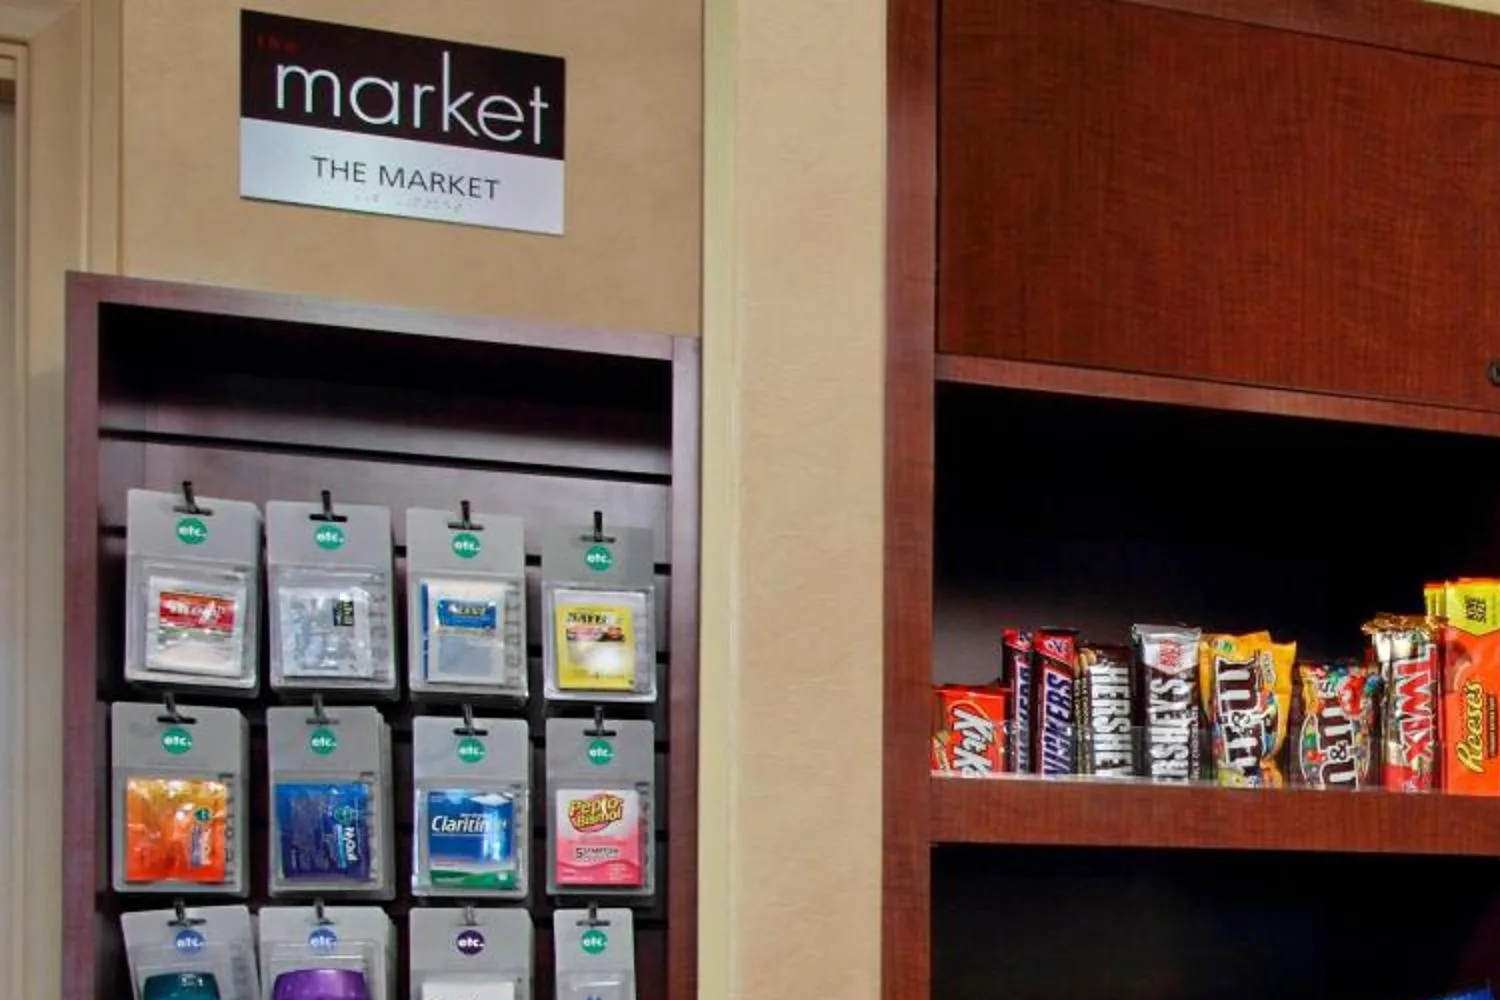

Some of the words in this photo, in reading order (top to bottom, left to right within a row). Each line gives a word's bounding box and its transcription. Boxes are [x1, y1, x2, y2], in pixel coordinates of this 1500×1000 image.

[275, 50, 549, 145] market
[311, 156, 367, 184] THE
[379, 165, 500, 200] MARKET
[178, 525, 207, 537] etc.
[316, 532, 344, 543] etc.
[1392, 649, 1438, 762] TWIX
[1151, 677, 1192, 781] ERSHEY'S
[1457, 681, 1486, 773] Reese's
[164, 735, 192, 747] etc.
[311, 736, 337, 748] etc.
[588, 747, 614, 758] etc.
[176, 936, 205, 949] etc.
[310, 935, 337, 948] etc.
[458, 936, 485, 947] etc.
[582, 936, 607, 947] etc.
